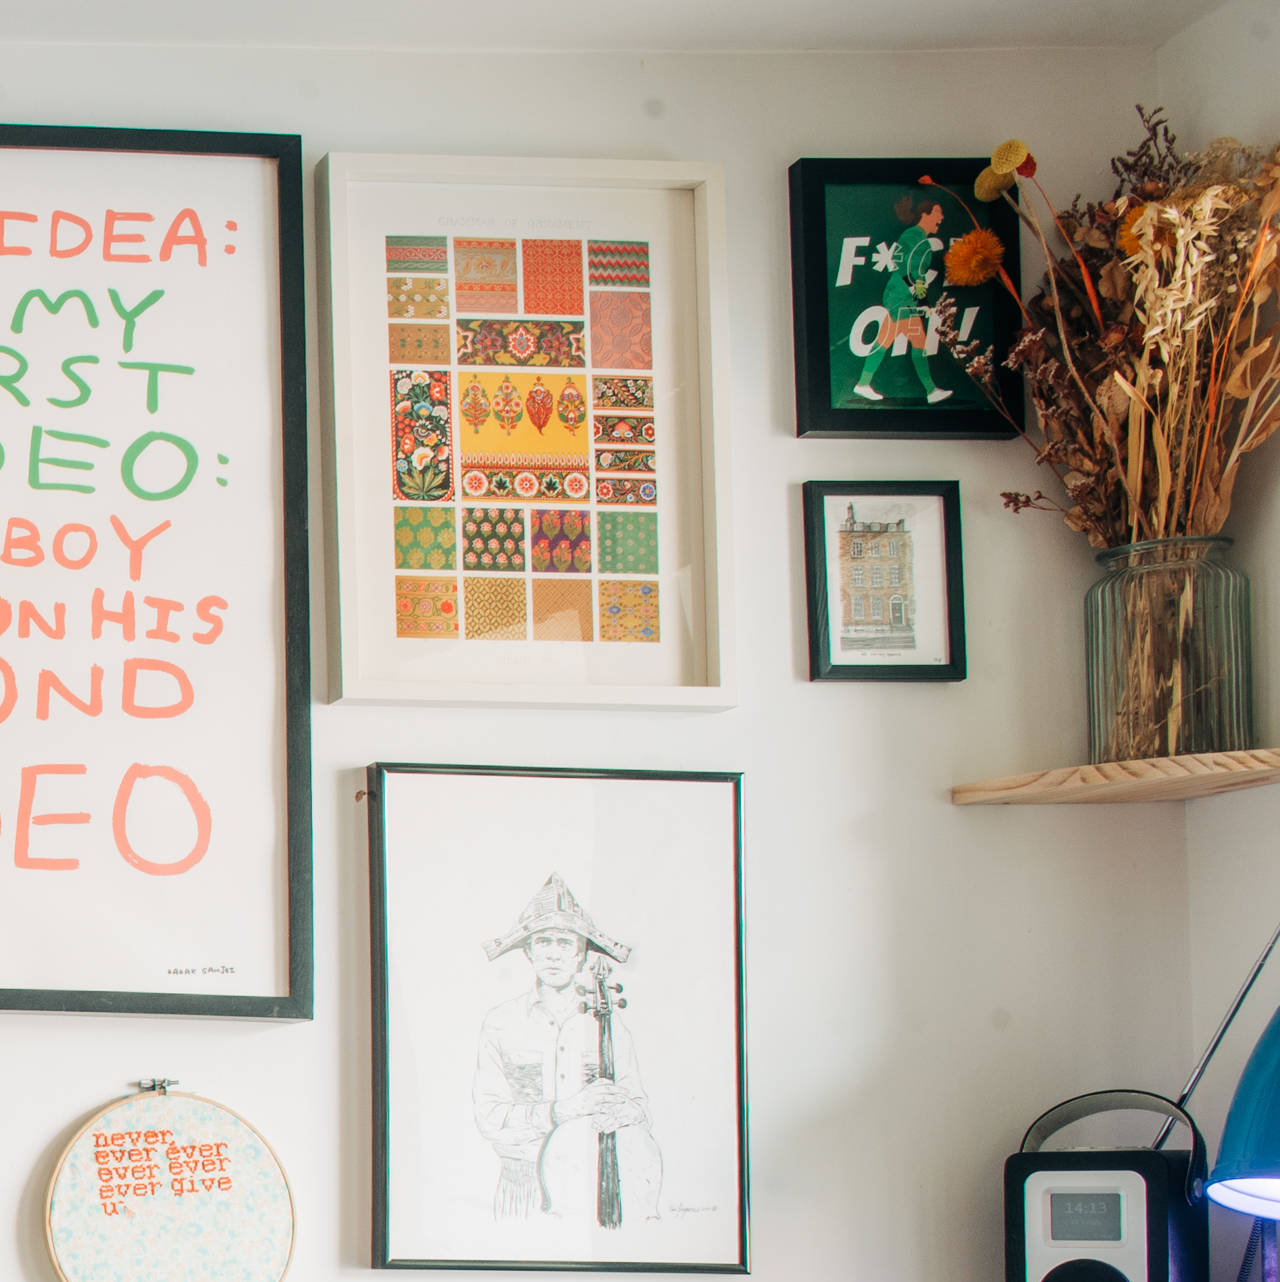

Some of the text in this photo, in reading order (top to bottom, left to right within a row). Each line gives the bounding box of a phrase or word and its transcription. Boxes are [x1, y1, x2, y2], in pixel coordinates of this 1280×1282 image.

[835, 236, 966, 288] FC
[10, 288, 164, 353] MY
[92, 588, 227, 644] HIS
[94, 1142, 229, 1165] ever ever
[97, 1157, 231, 1183] ever ever
[99, 1176, 232, 1199] ever give
